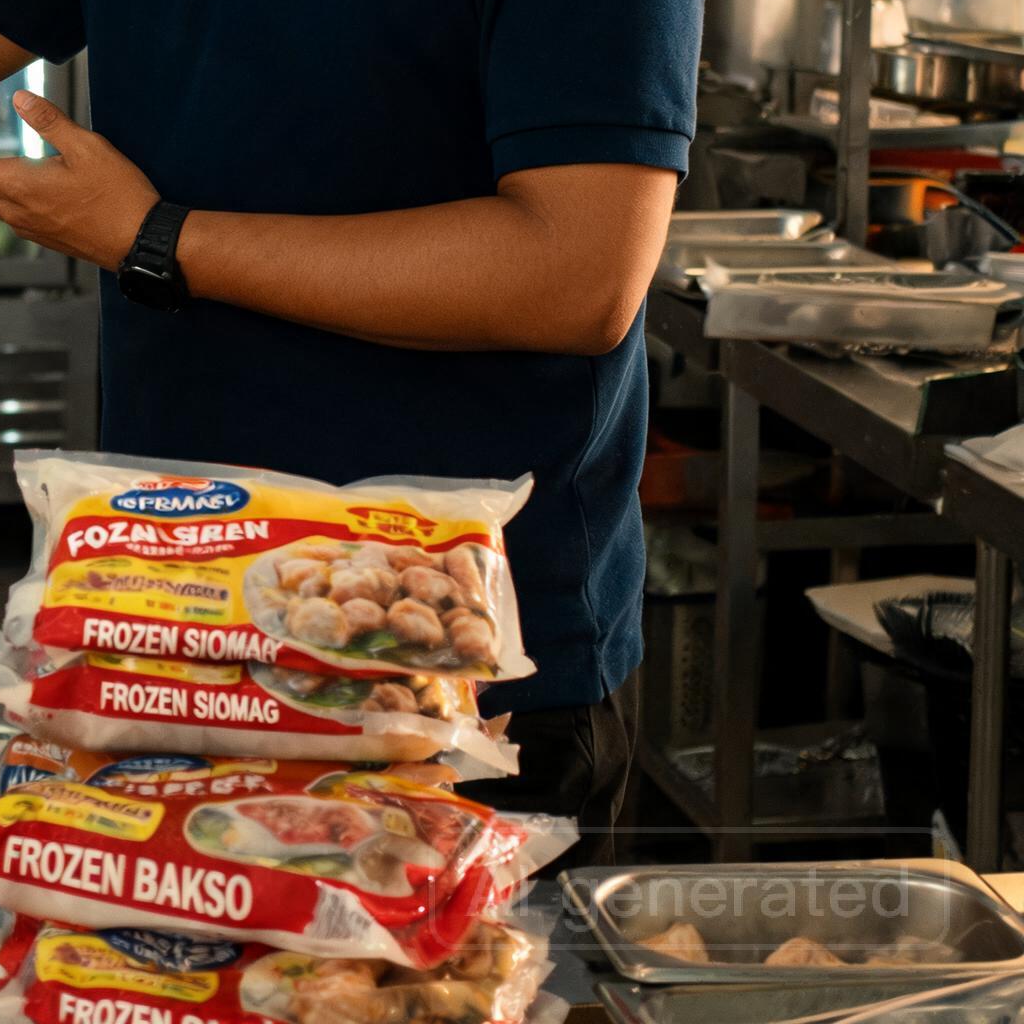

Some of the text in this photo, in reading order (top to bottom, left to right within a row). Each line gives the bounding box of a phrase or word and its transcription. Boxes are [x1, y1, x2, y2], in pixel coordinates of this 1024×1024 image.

[82, 617, 179, 656] FROZEN
[100, 681, 280, 724] FROZEN SIOMAG
[3, 834, 254, 922] FROZEN BAKSO
